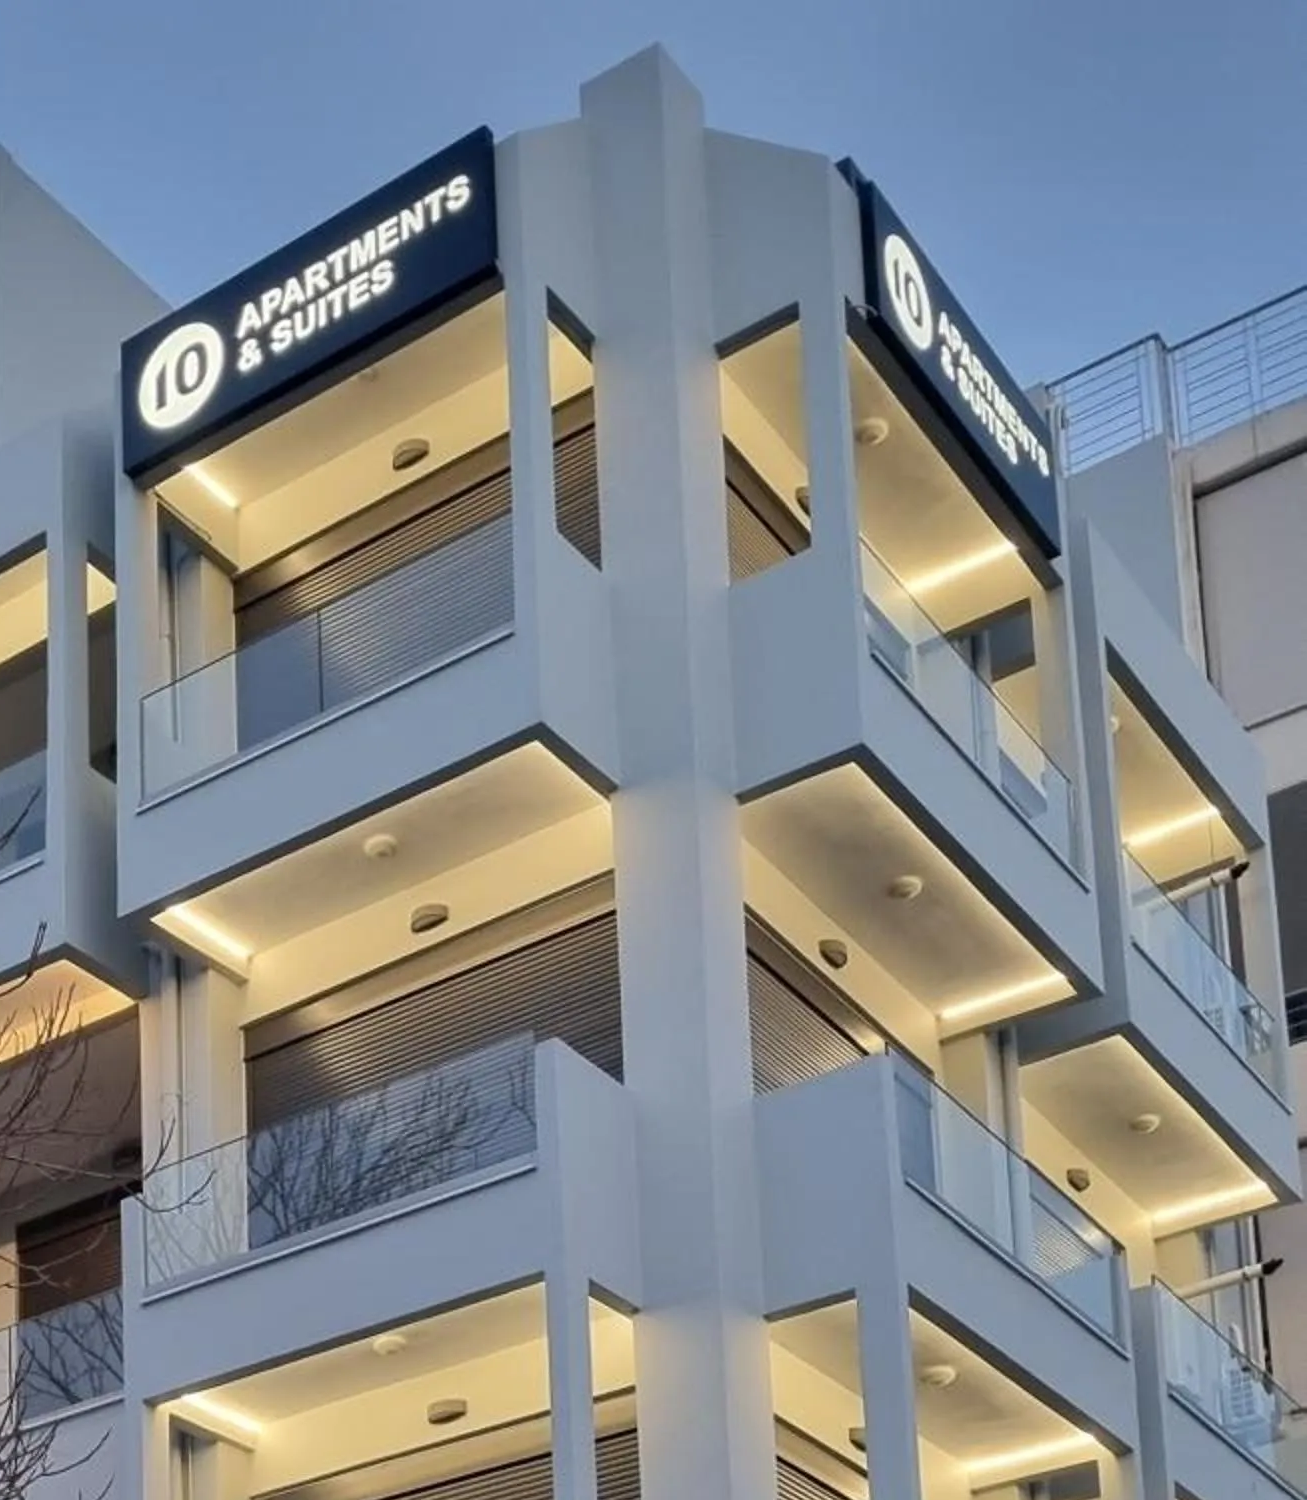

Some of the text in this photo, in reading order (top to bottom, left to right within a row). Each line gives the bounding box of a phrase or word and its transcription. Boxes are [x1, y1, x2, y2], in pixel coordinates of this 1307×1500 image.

[236, 173, 472, 339] APARTMENTS
[892, 258, 923, 329] 10
[237, 259, 397, 373] & SUITES
[154, 341, 209, 411] 10
[938, 310, 1049, 477] APARTMENTS
[957, 363, 1019, 466] SUITES
